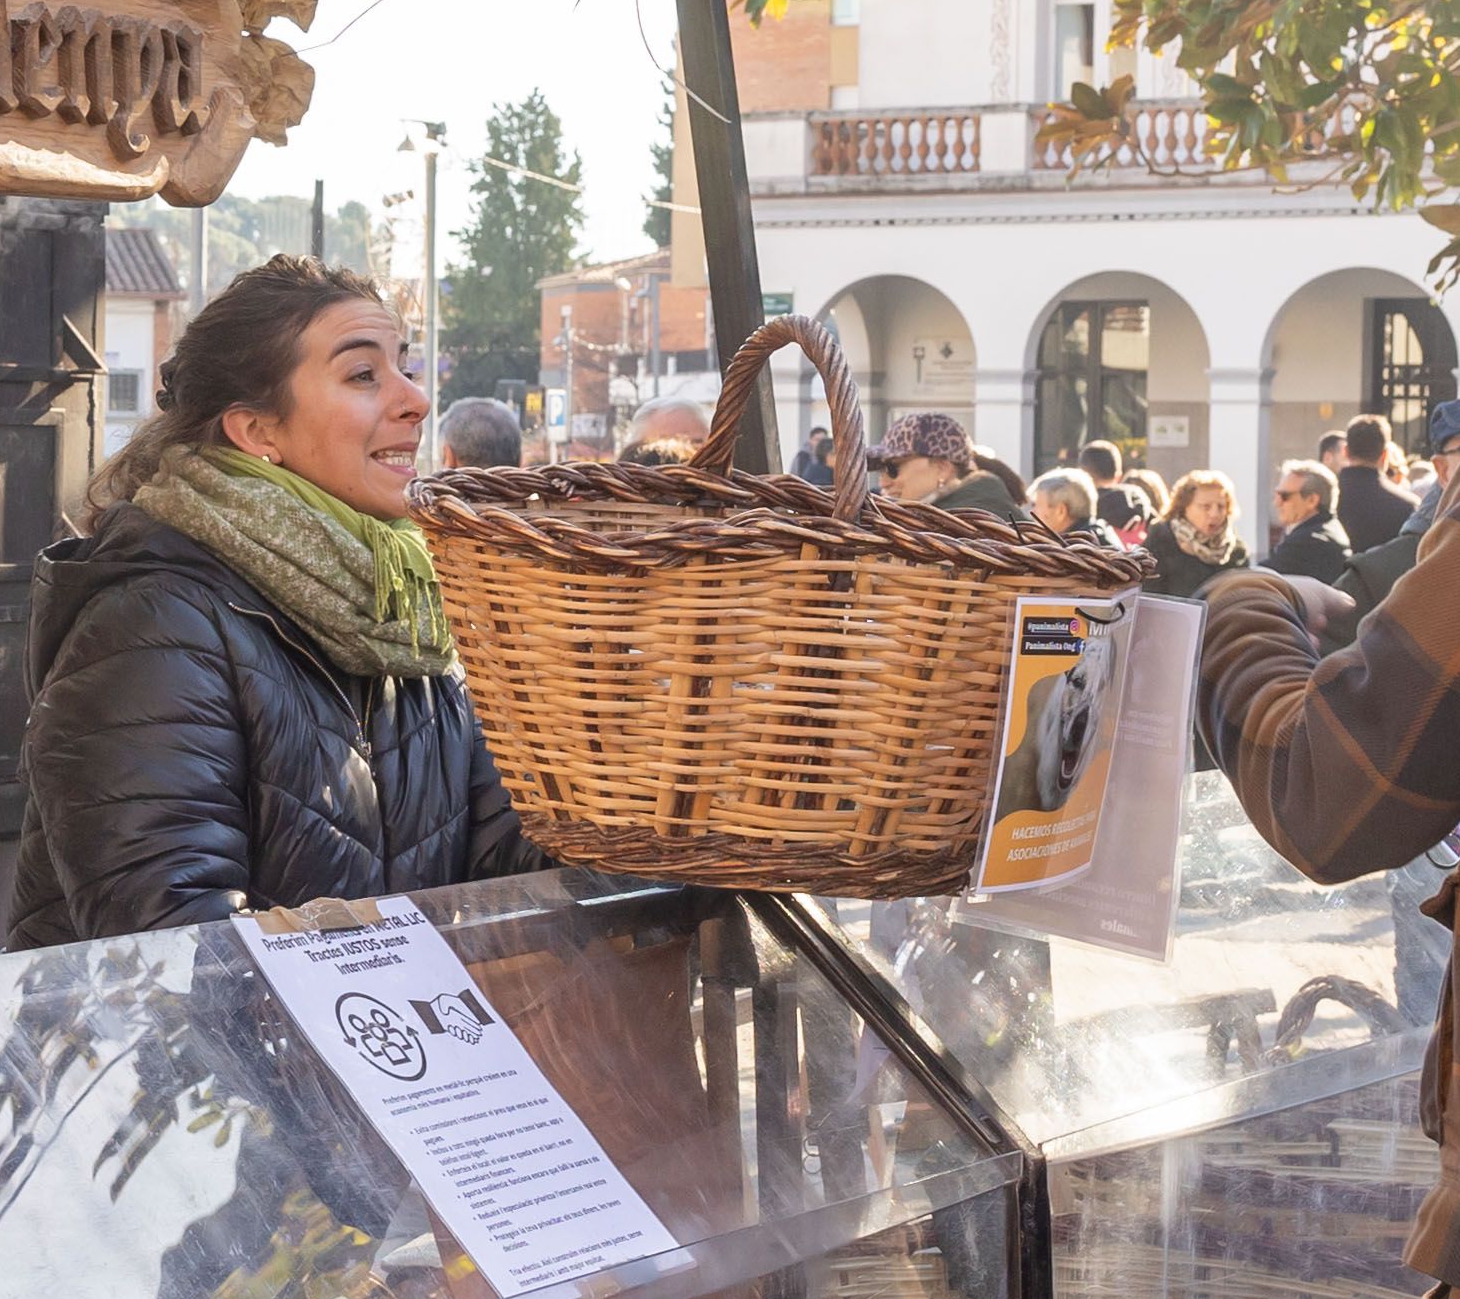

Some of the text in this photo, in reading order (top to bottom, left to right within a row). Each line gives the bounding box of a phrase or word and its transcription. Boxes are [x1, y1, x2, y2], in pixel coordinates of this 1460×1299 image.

[260, 934, 310, 953] Preferim
[303, 935, 410, 963] Tractes JUSTOS sense
[333, 951, 406, 976] Intermediaris.
